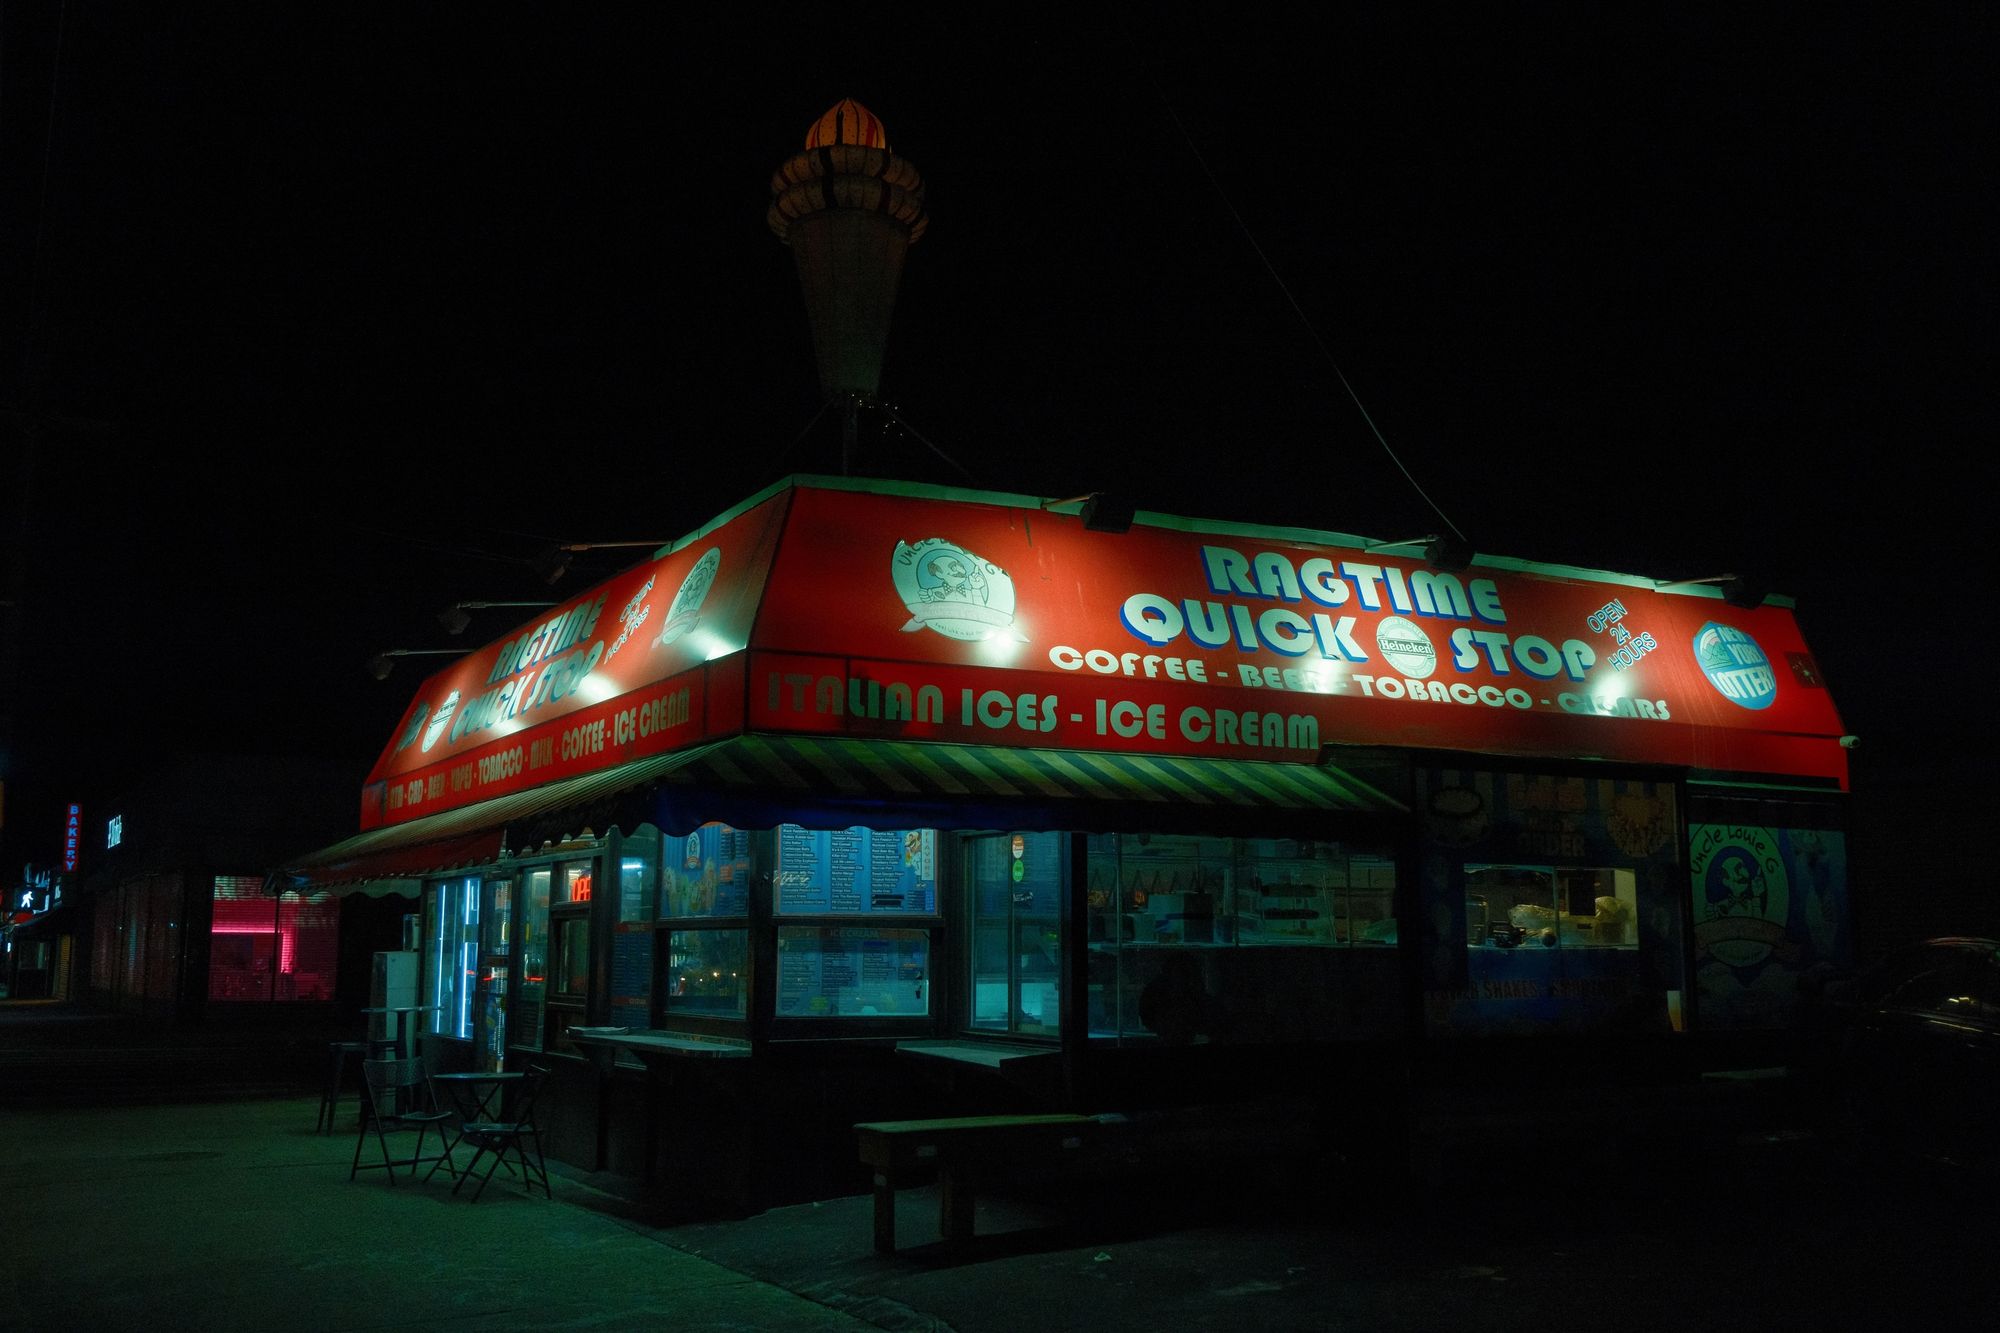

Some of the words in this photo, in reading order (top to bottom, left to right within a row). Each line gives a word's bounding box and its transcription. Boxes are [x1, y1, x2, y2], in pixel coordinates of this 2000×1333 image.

[1201, 545, 1507, 625] RAGTIME
[486, 591, 609, 687] RAGTIME
[1119, 593, 1369, 662] QUICK
[1449, 628, 1596, 682] STOP
[1586, 598, 1628, 634] OPEN
[1609, 622, 1631, 646] 24
[1717, 626, 1749, 643] NEW
[1380, 639, 1434, 654] Heineken
[1607, 632, 1658, 672] HOURS
[1726, 643, 1764, 665] YORK
[520, 640, 605, 715] STOP
[1049, 645, 1208, 683] COFFEE
[1353, 674, 1532, 709] TOBACCO
[1710, 665, 1775, 699] LOTTERY
[479, 745, 524, 786] TOBACCO
[562, 719, 605, 762] COFFEE
[614, 708, 637, 746] ICE
[640, 687, 690, 738] CREAM
[768, 671, 944, 724] ITALIAN
[962, 688, 1058, 732] ICES
[1095, 698, 1166, 739] ICE
[1180, 711, 1319, 750] CREAM
[66, 805, 78, 871] BAKERY
[572, 877, 592, 902] OPE
